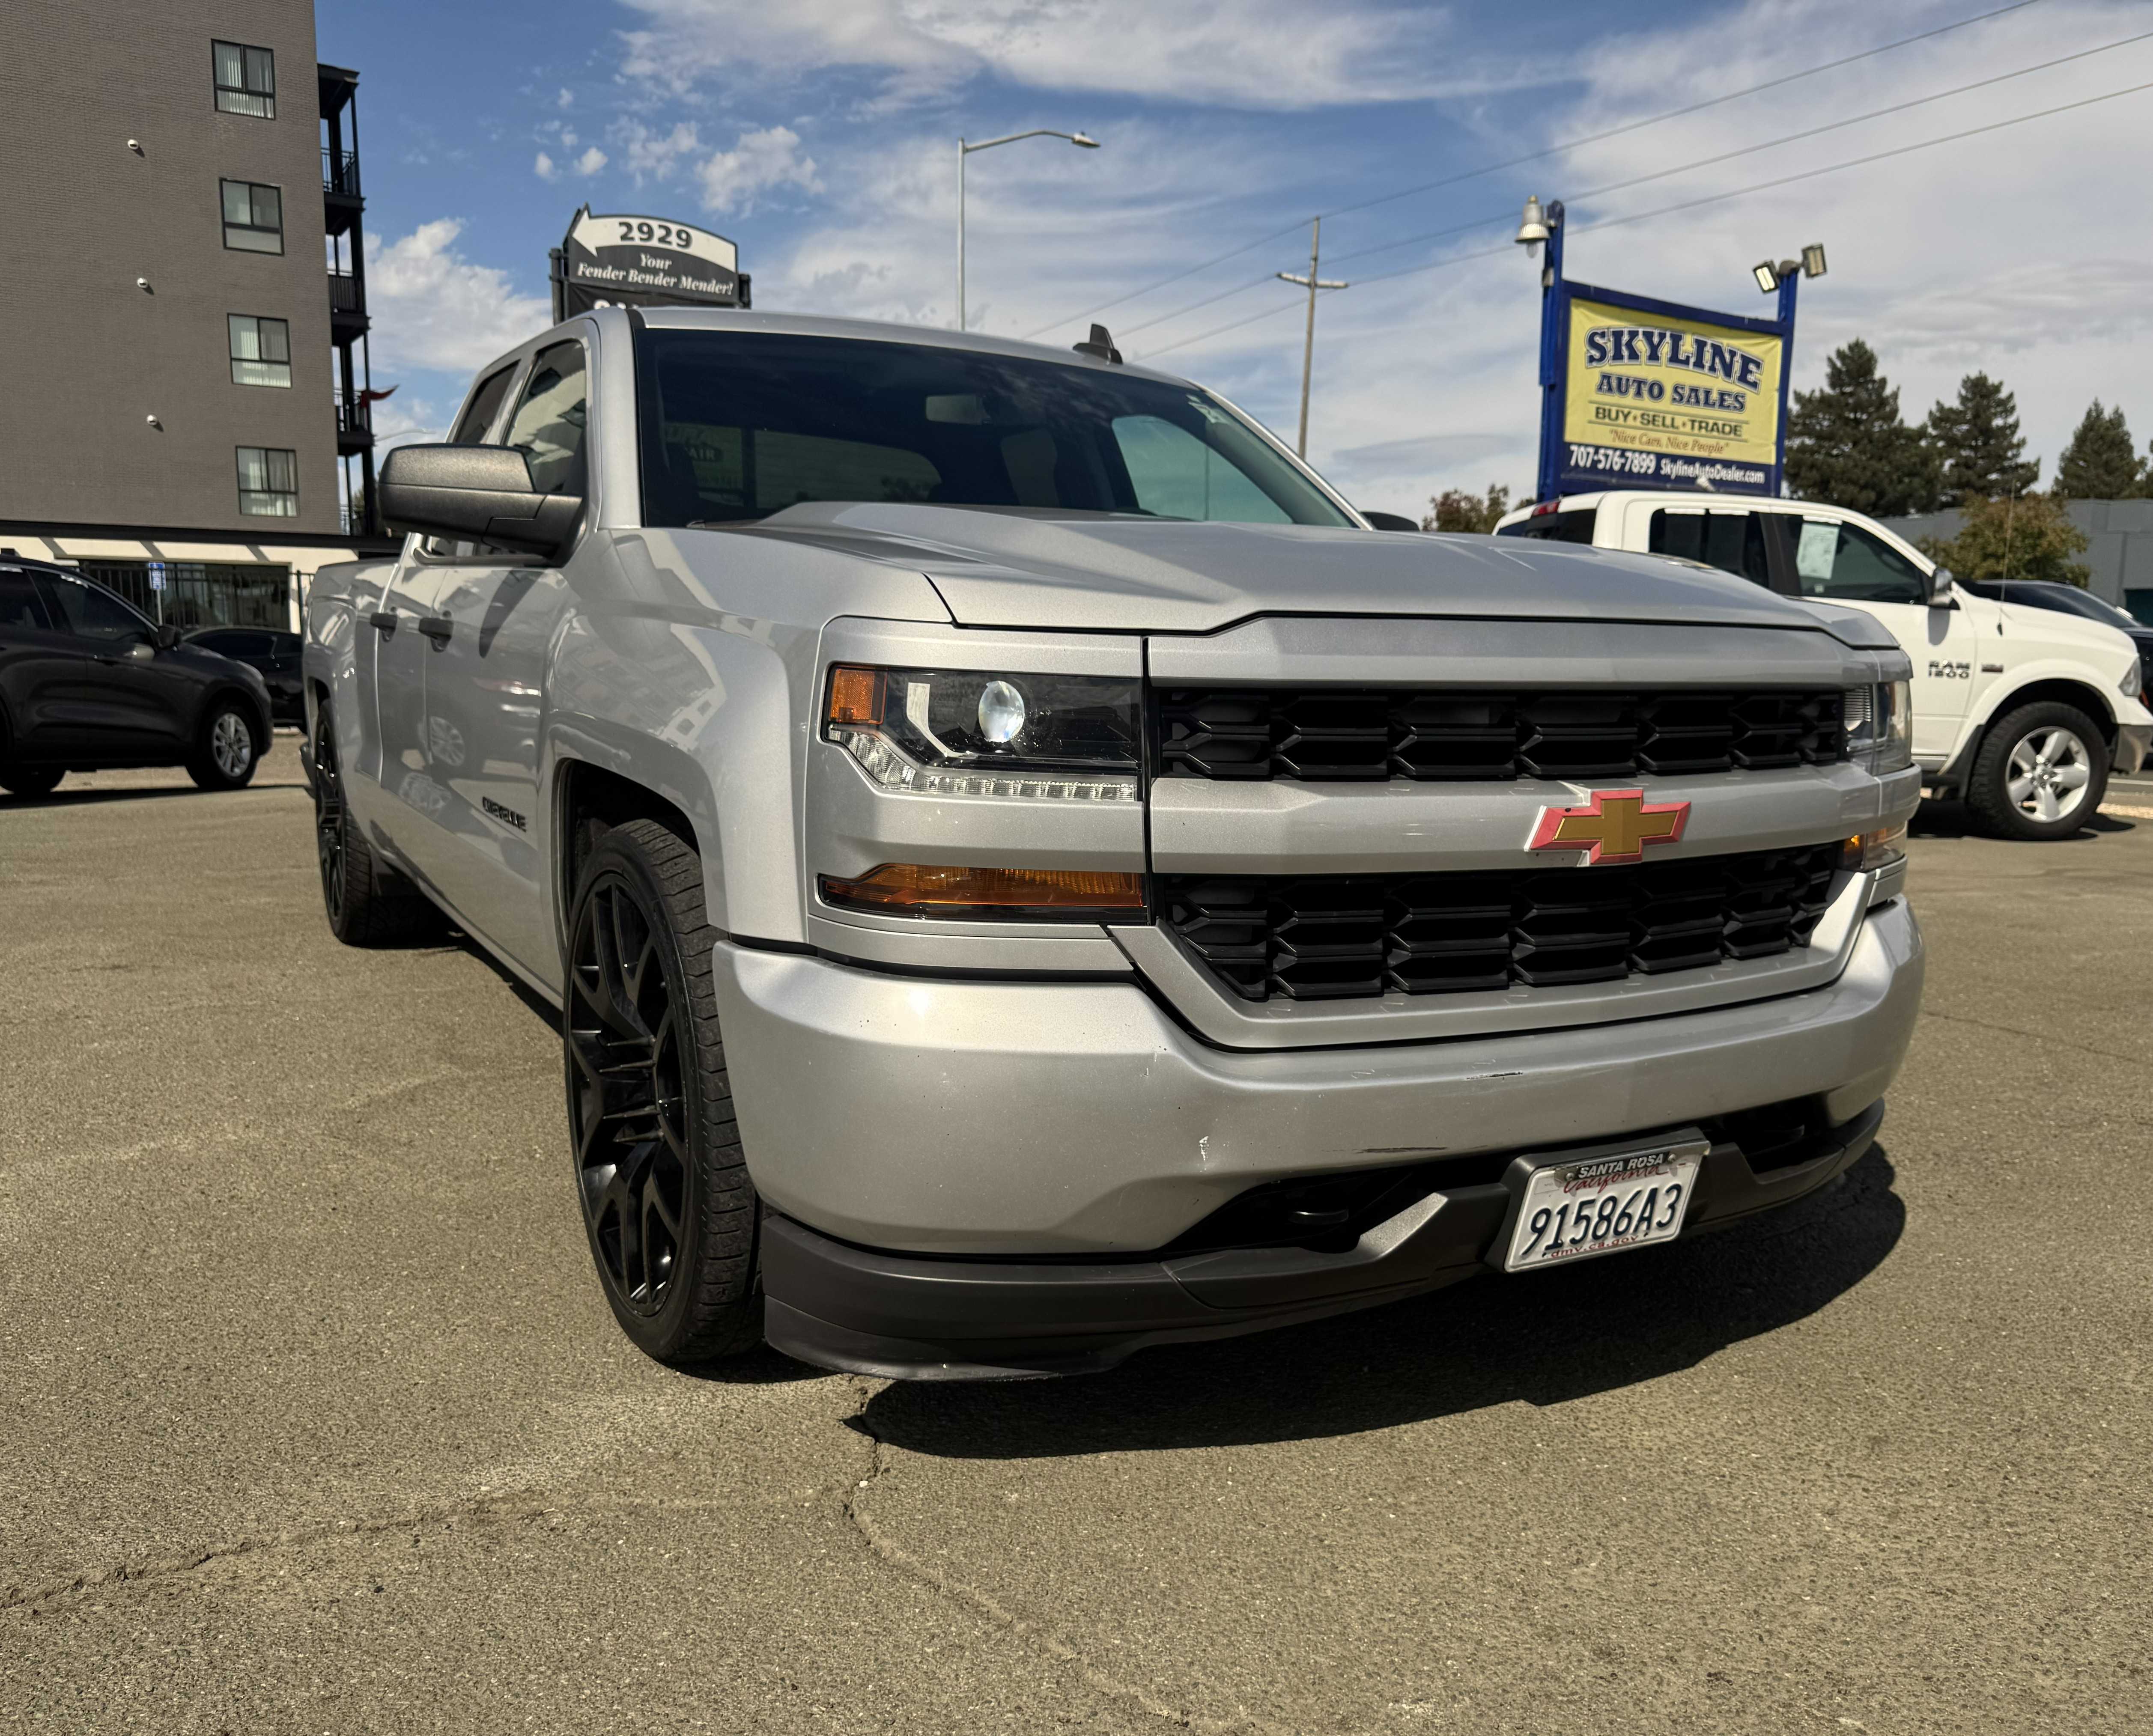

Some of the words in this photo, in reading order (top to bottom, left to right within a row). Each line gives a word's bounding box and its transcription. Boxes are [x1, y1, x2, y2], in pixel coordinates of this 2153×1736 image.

[619, 222, 693, 249] 2929
[640, 253, 671, 270] Your
[578, 262, 626, 280] Fender
[628, 269, 677, 288] Bender
[679, 275, 733, 295] Mender!
[1585, 326, 1764, 394] SKYLINE
[1595, 372, 1664, 402] AUTO
[1671, 385, 1746, 412] SALES
[1595, 408, 1631, 422] BUY
[1640, 414, 1678, 429] SELL
[1688, 420, 1741, 437] TRADE
[1666, 437, 1689, 451] Nice
[1569, 445, 1656, 474] 707-576-7899
[1660, 458, 1765, 484] SkylineAutoDealer.com
[1563, 1166, 1669, 1194] California
[1578, 1162, 1623, 1179] SANTA
[1627, 1153, 1664, 1170] ROSA
[1521, 1184, 1682, 1256] 91586A3
[1551, 1235, 1638, 1258] dmv.ca.gov
